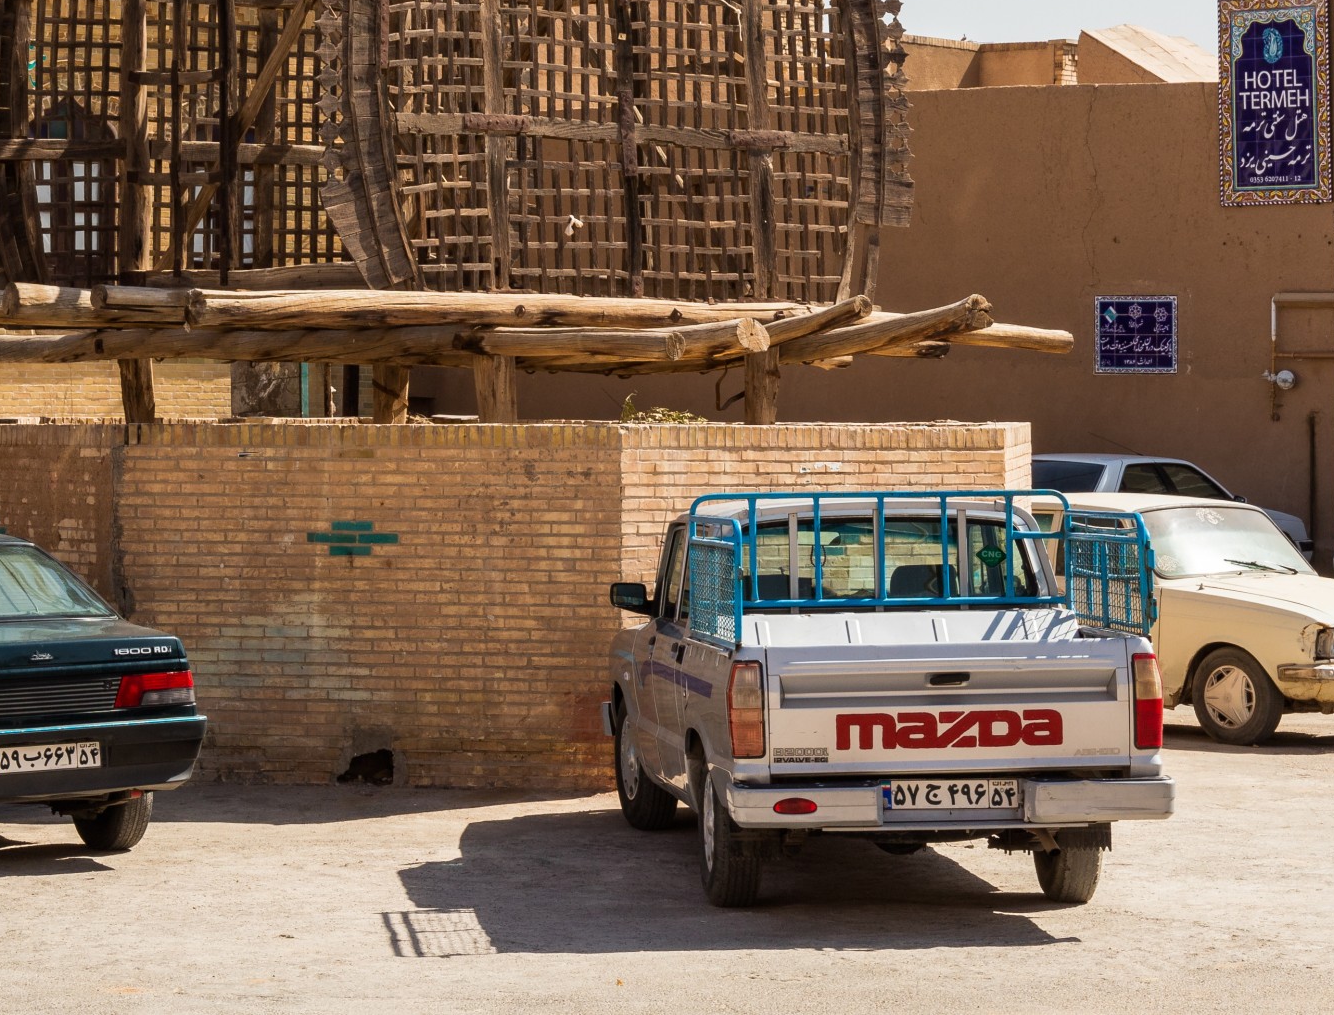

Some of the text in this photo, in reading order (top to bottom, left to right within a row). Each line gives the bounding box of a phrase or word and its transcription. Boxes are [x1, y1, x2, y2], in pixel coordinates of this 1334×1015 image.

[1244, 69, 1302, 89] HOTEL
[1239, 89, 1309, 110] TERMEH
[1243, 109, 1308, 141] هتل سنتی ترمه
[1240, 145, 1312, 175] ترمه حسینی یزد
[1249, 176, 1264, 184] 0353
[981, 550, 1002, 558] CNG
